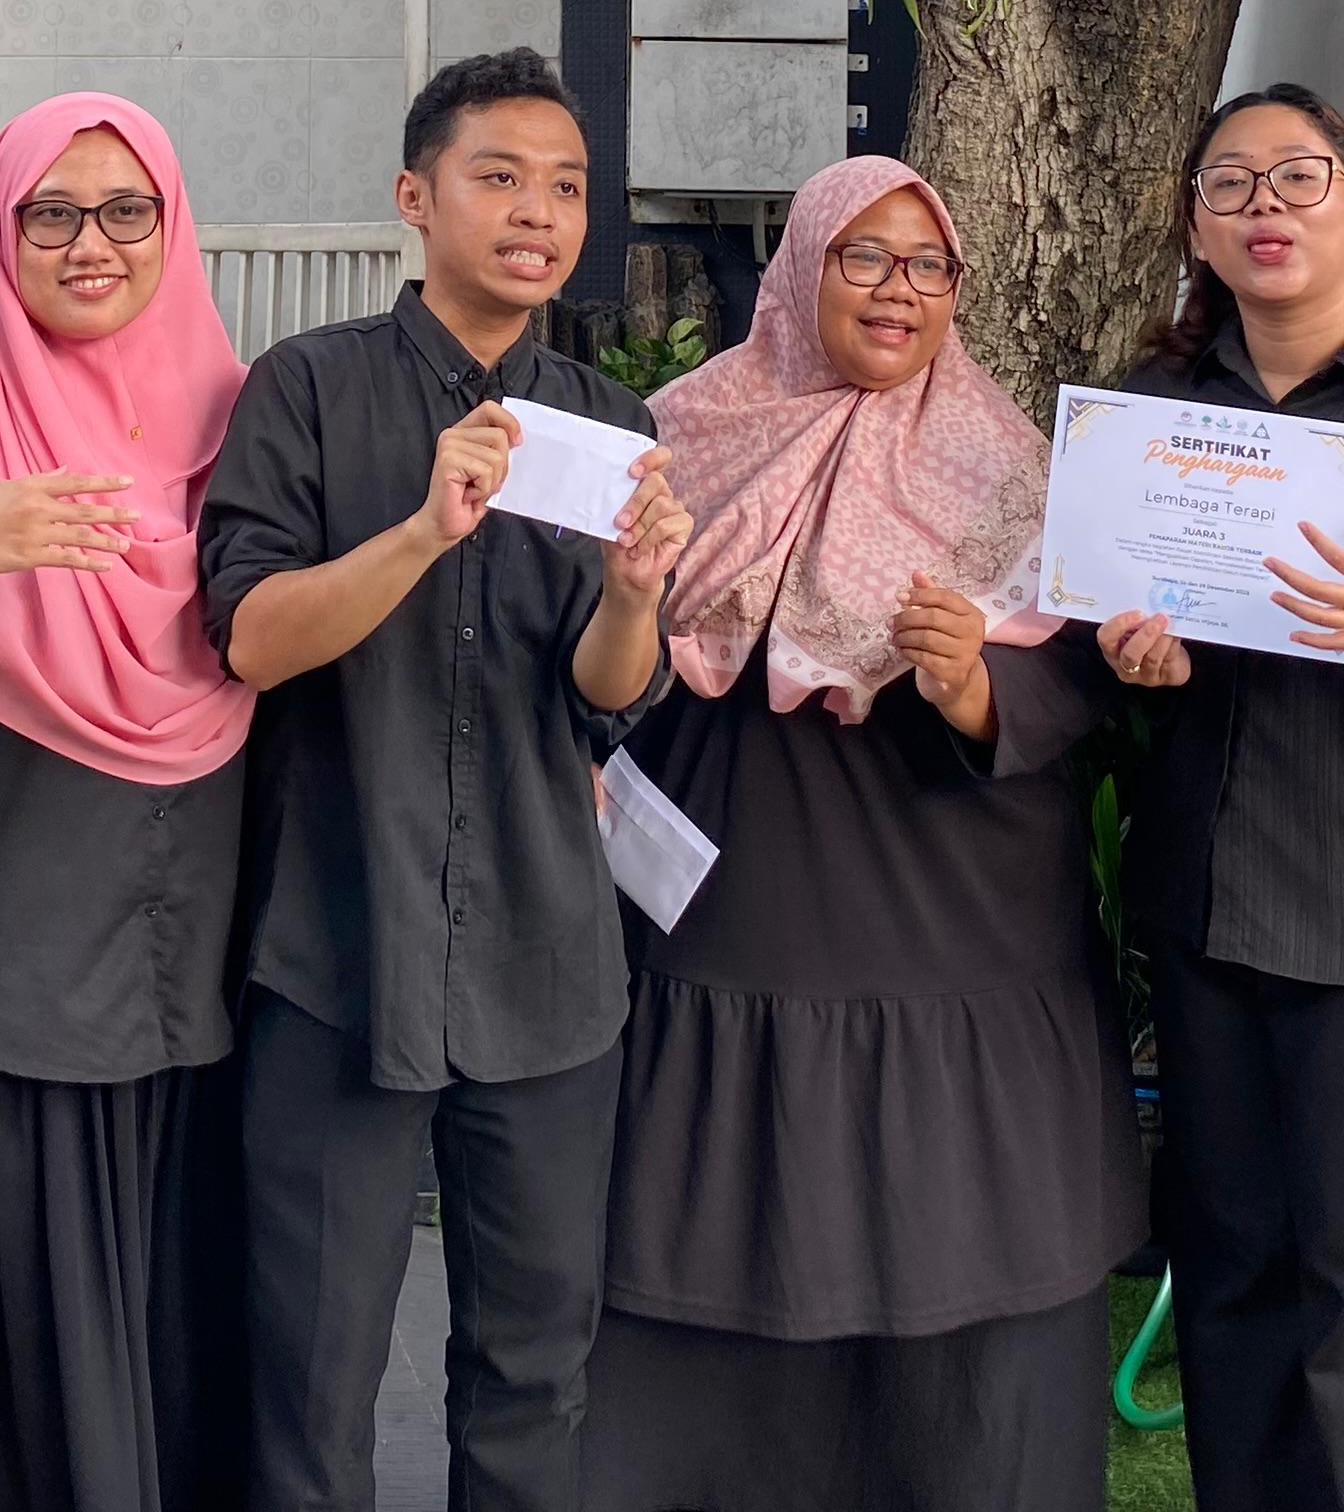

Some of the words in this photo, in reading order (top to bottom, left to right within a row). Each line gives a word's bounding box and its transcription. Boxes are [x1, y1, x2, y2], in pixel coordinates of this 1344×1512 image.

[1144, 439, 1287, 486] Penghargaan
[1171, 435, 1271, 461] SERTIFIKAT
[1145, 490, 1219, 513] Lembaga
[1225, 501, 1276, 522] Terapi
[1182, 527, 1217, 540] JUARA
[1219, 532, 1226, 540] 3
